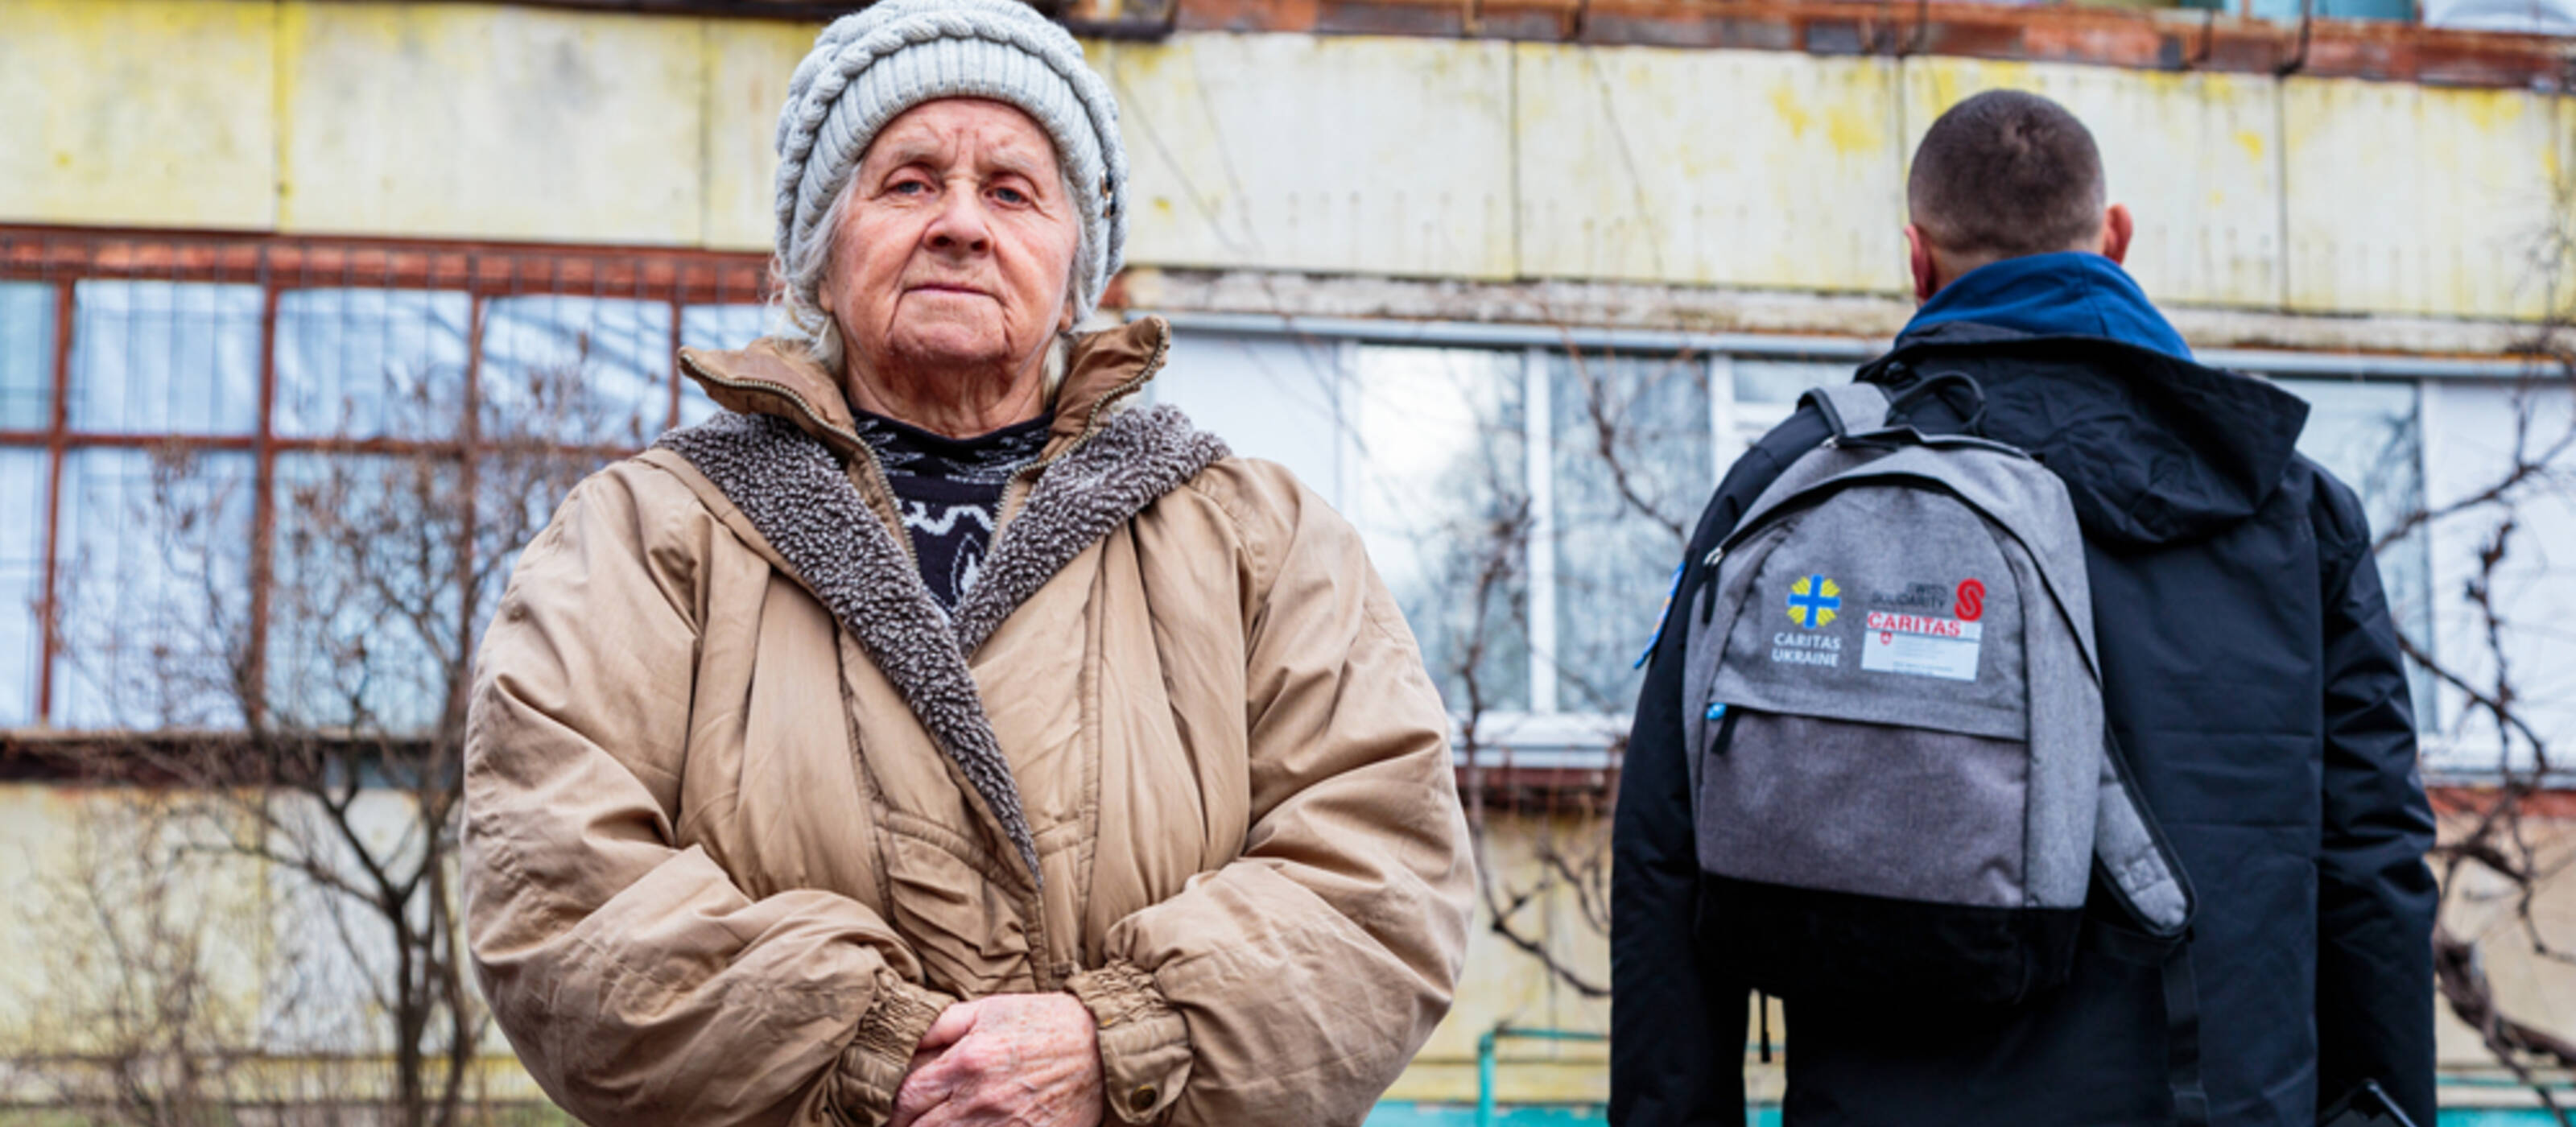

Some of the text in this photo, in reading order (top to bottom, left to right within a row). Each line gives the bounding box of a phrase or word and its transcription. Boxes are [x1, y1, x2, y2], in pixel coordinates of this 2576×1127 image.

[1868, 612, 1961, 638] CARITAS
[1773, 632, 1842, 650] CARITAS
[1772, 648, 1839, 667] UKRAINE
